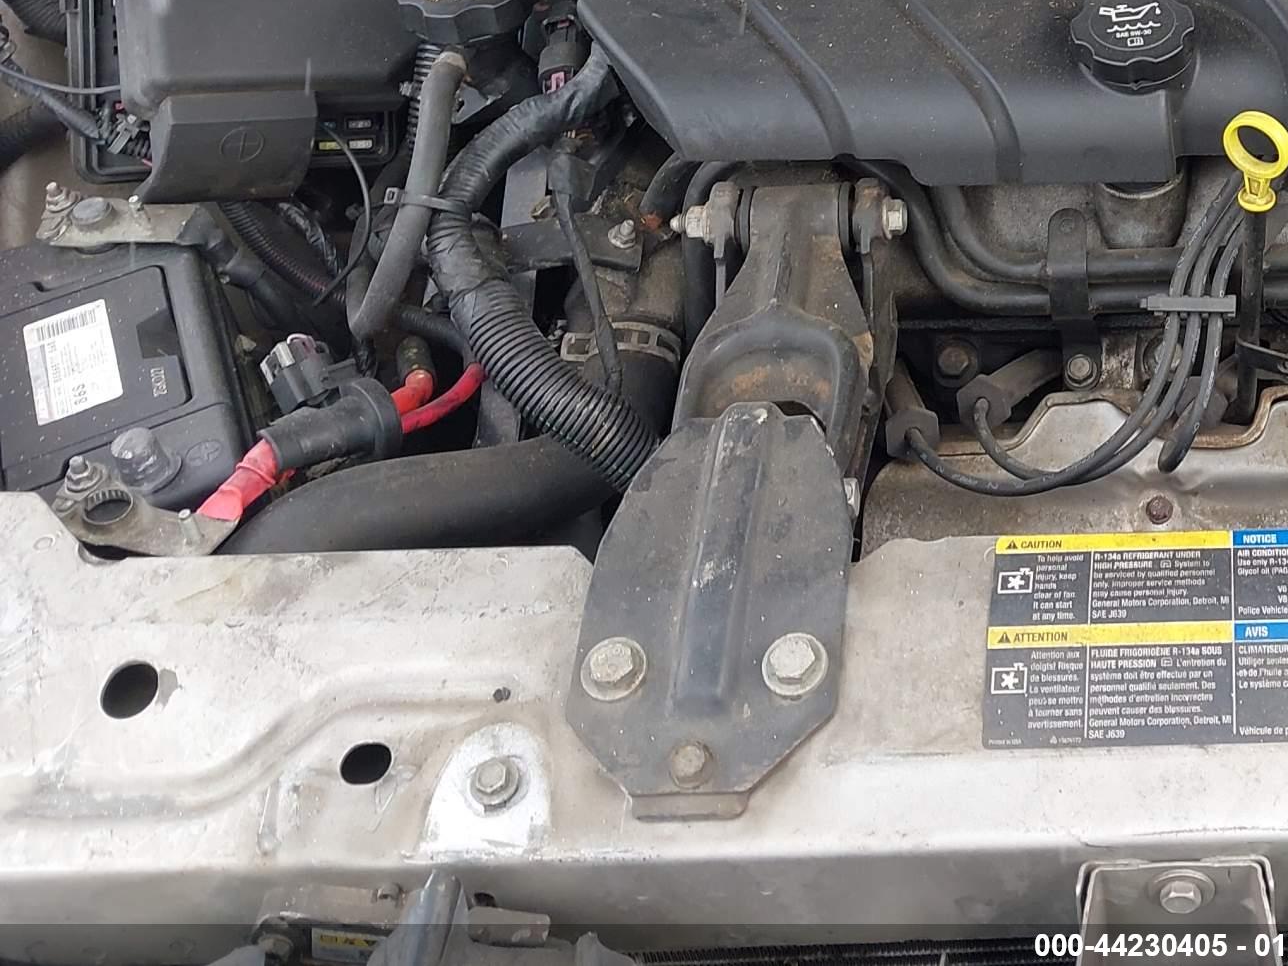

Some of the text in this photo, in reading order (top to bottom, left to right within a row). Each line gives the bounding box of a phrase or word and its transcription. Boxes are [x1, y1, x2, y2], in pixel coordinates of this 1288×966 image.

[1243, 534, 1277, 543] NOTICE
[1020, 540, 1062, 548] CAUTION
[1245, 626, 1268, 637] AVIS
[1013, 632, 1067, 642] ATTENTION
